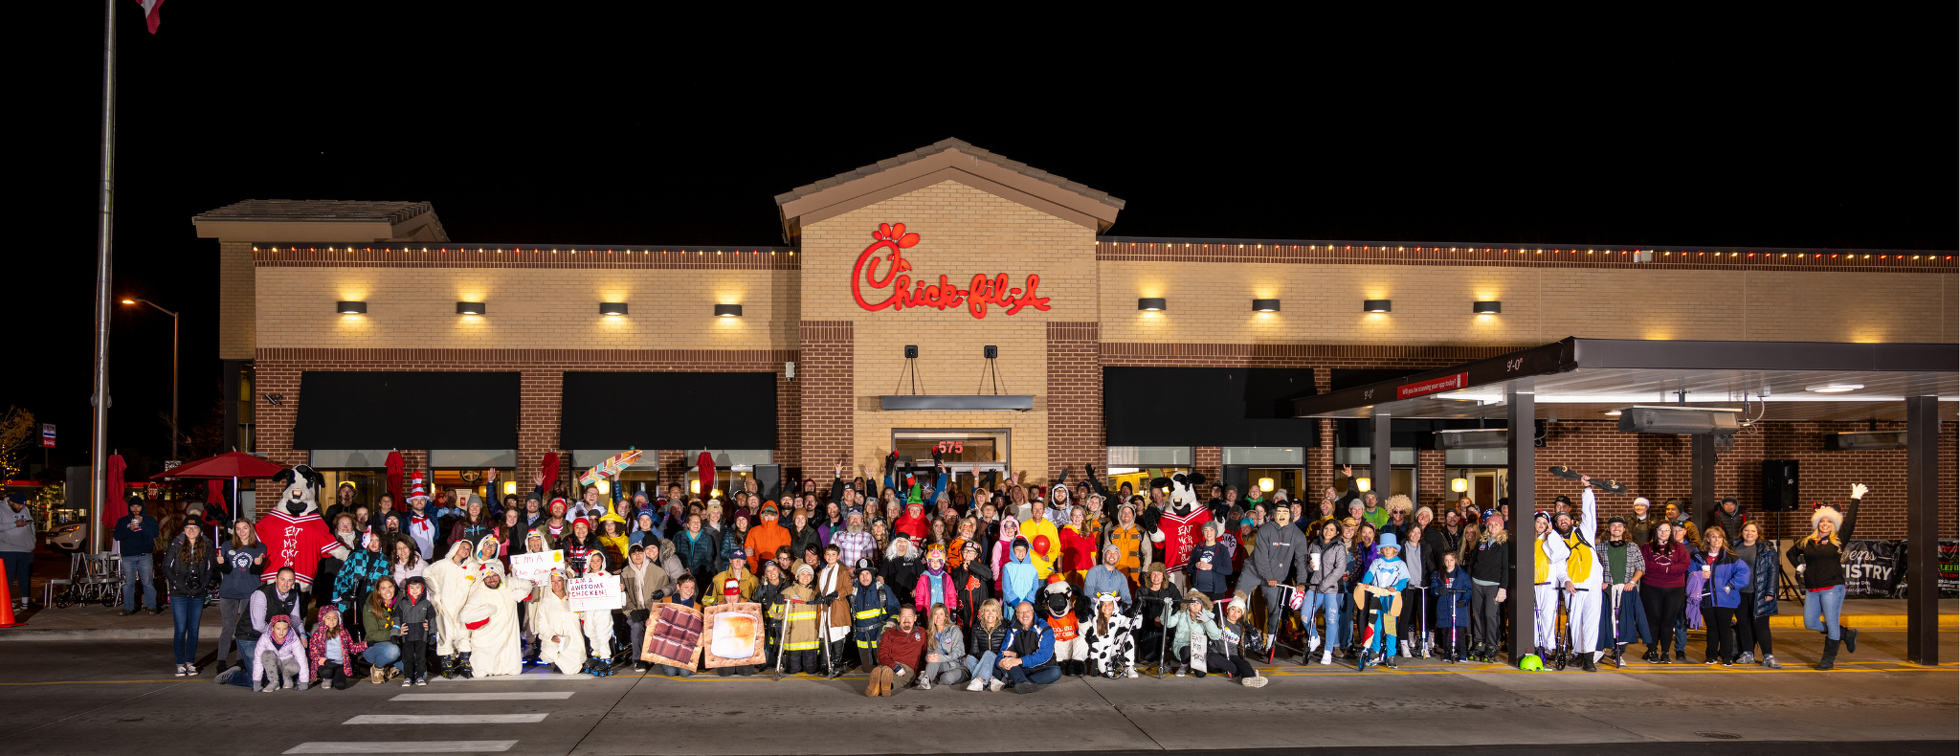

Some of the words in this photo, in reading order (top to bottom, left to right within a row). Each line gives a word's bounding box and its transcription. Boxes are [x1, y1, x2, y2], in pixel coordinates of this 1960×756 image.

[853, 239, 1051, 319] Chick-fil-A
[1418, 384, 1432, 392] scanning
[1445, 378, 1456, 387] today?
[939, 441, 963, 454] 575
[148, 488, 158, 496] STOP
[536, 554, 543, 562] A
[571, 583, 604, 592] AWESOME
[571, 590, 608, 598] CHICKEN!
